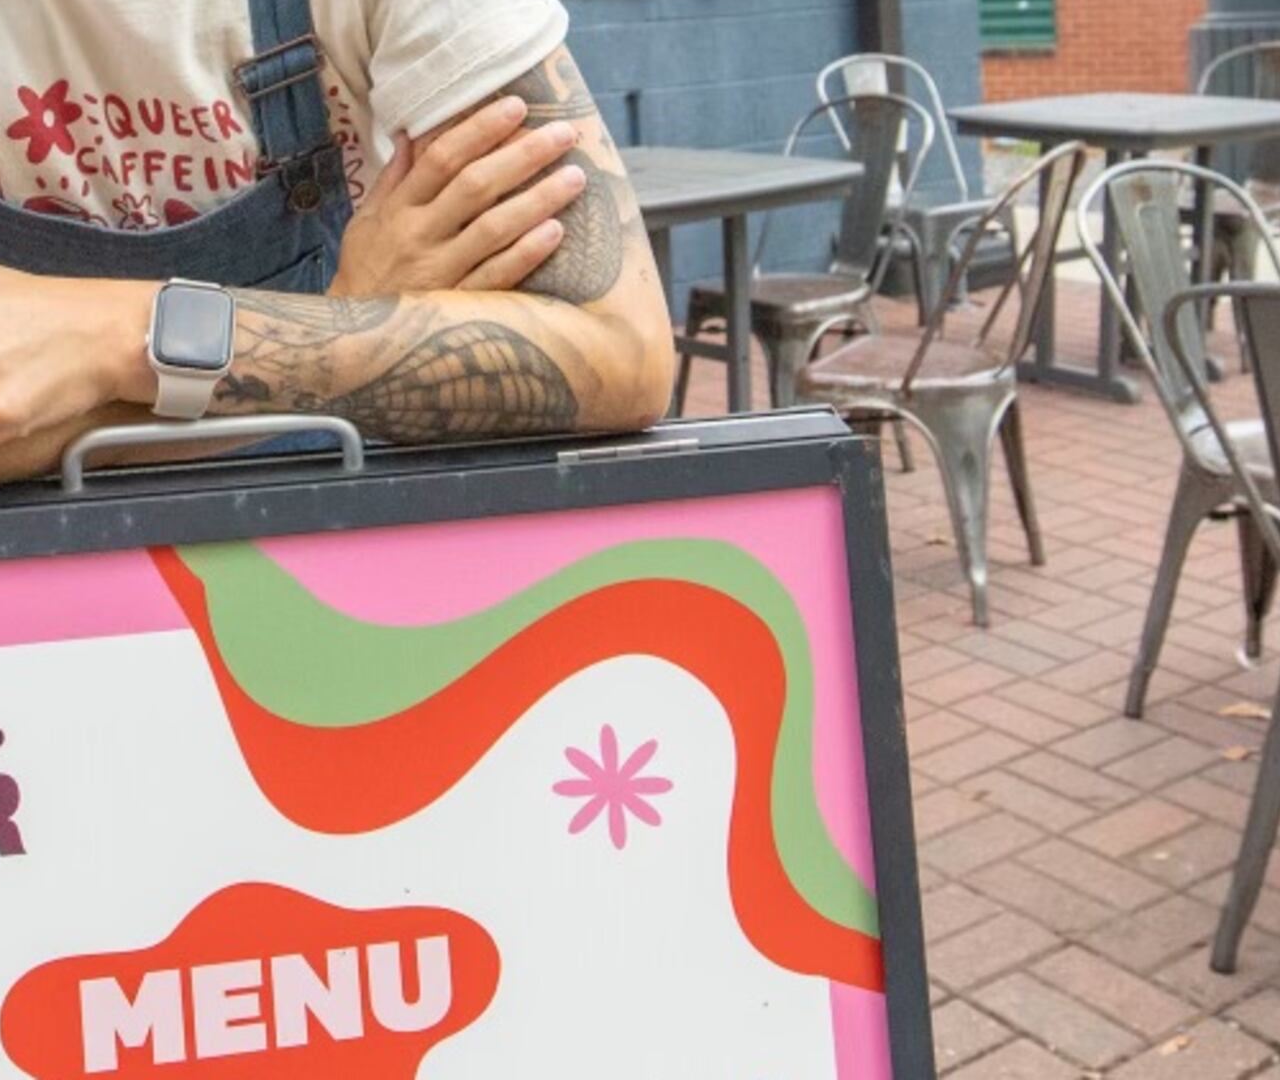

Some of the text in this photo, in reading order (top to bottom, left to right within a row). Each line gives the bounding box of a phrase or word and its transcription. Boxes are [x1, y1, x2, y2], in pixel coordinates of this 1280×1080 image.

[104, 94, 243, 143] QUEER
[76, 146, 253, 191] CAFFEIN
[79, 934, 452, 1073] MENU
